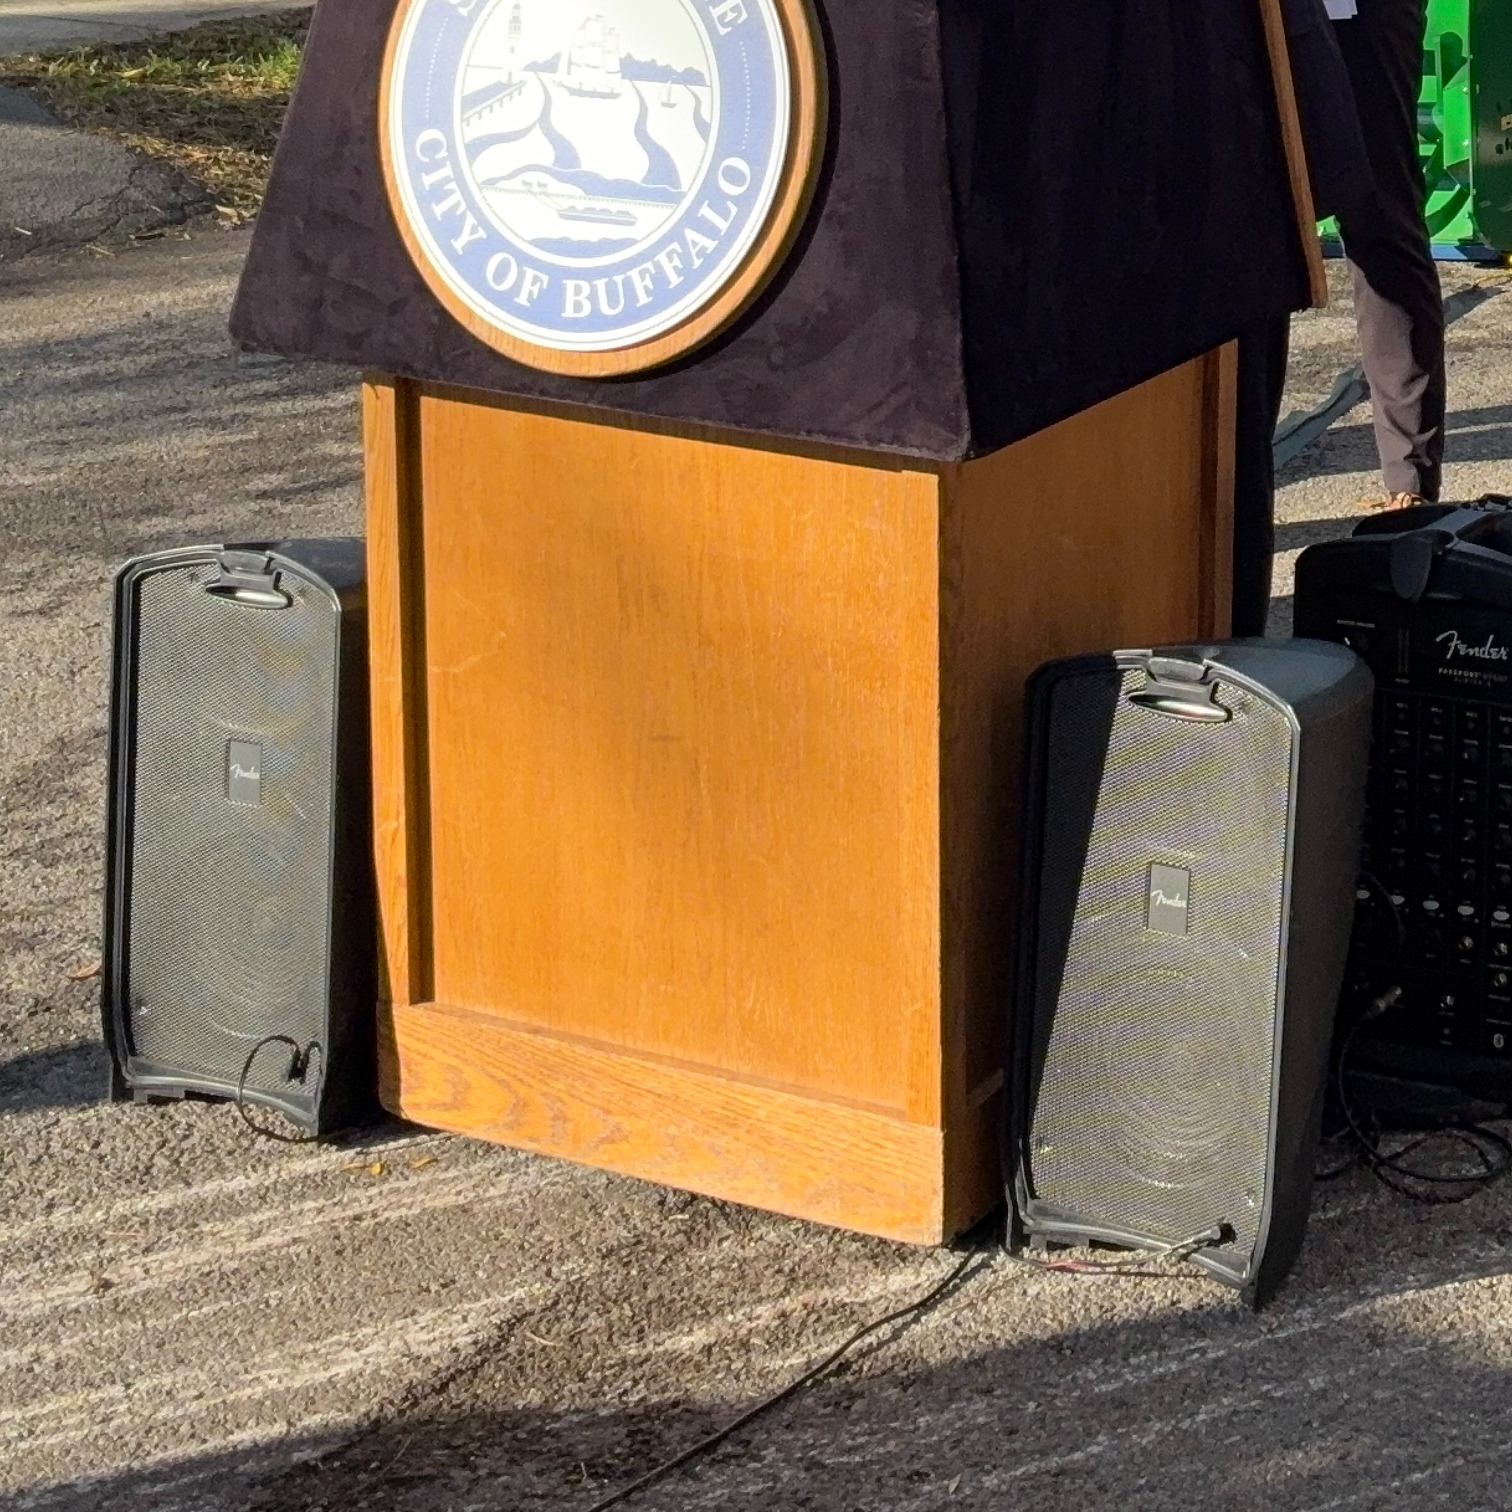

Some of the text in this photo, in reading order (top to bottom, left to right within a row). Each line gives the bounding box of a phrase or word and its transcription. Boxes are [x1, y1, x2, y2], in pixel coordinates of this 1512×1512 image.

[415, 128, 752, 318] CITY OF BUFFALO
[1435, 630, 1508, 661] Fender
